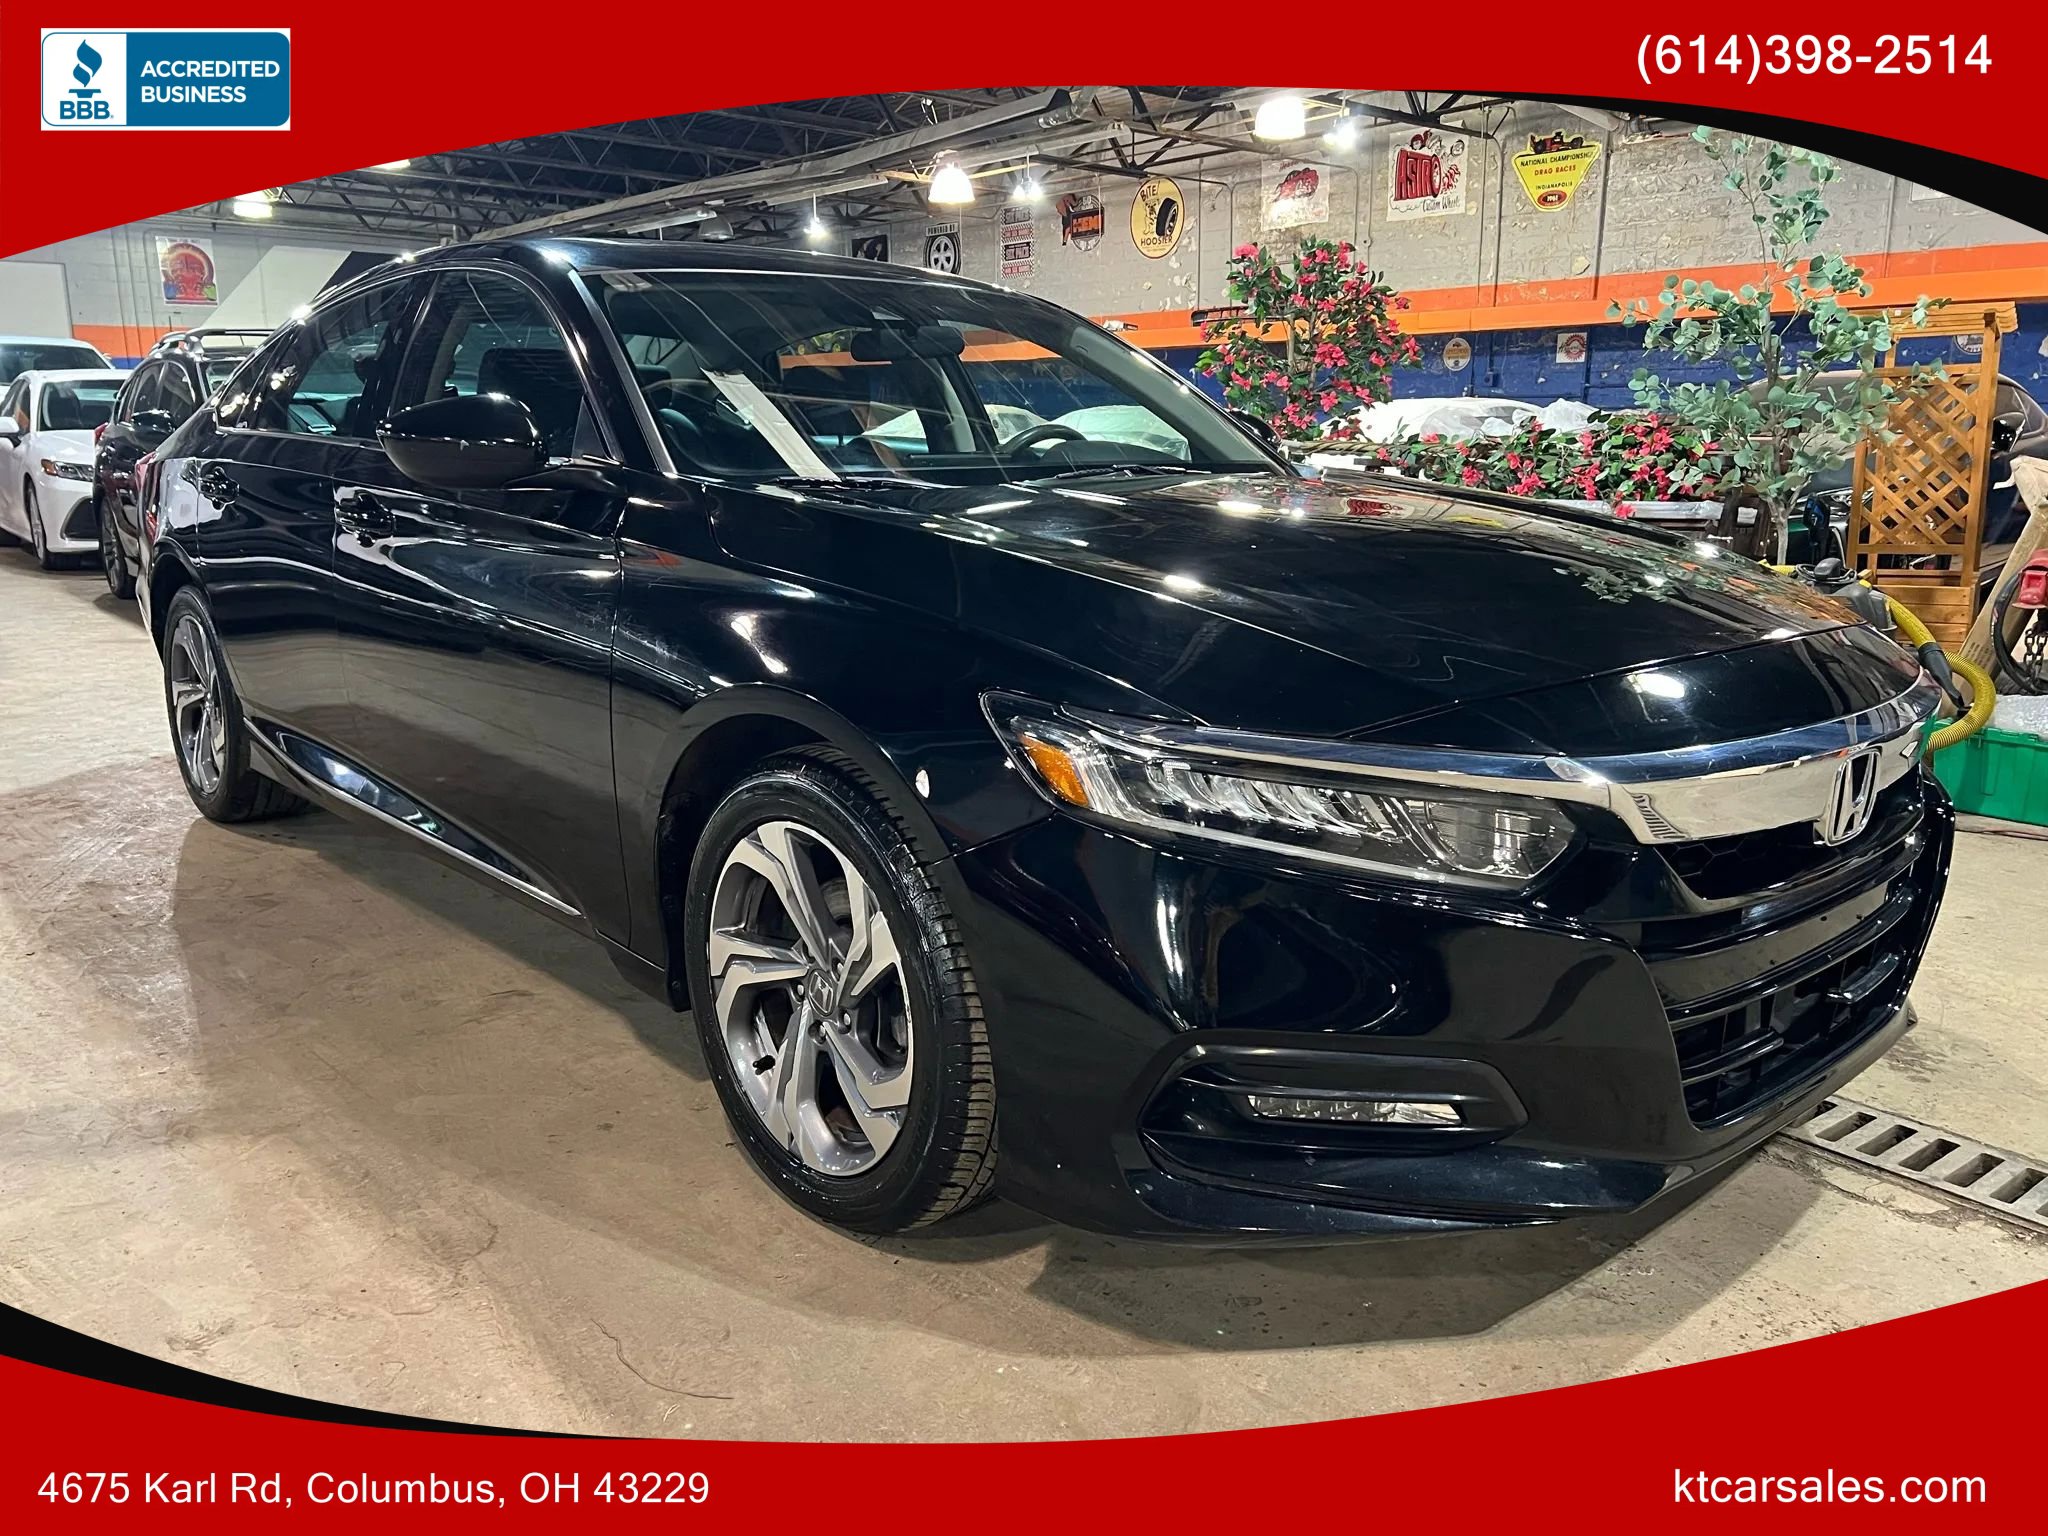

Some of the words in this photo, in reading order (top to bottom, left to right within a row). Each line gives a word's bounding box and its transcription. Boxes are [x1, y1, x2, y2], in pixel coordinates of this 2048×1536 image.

[1520, 157, 1547, 167] NATIONAL
[1393, 147, 1441, 199] ASTRO
[1534, 168, 1553, 176] DRAG
[1555, 165, 1576, 173] RACES
[1140, 236, 1173, 247] HOOSIER
